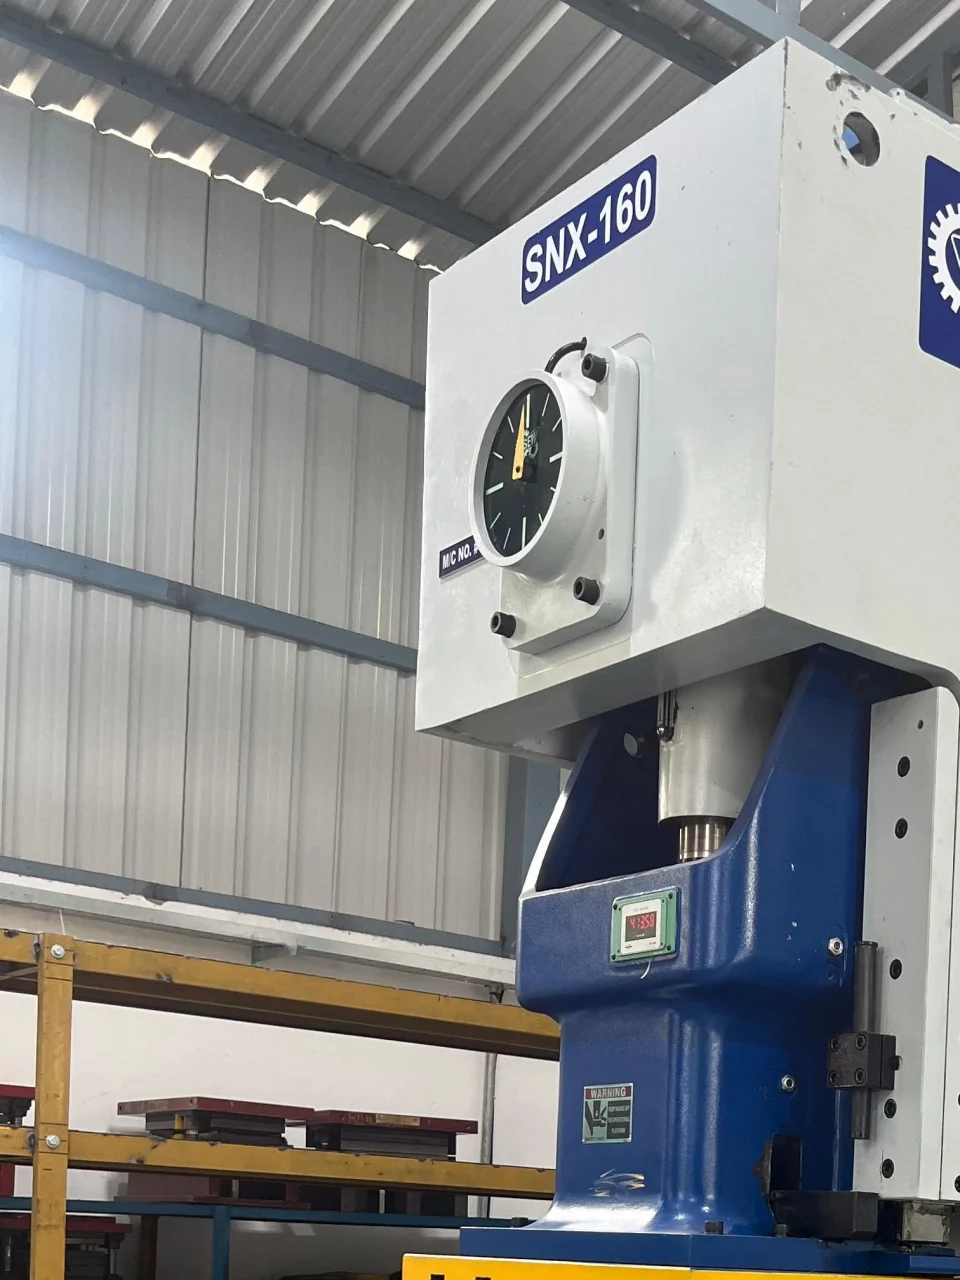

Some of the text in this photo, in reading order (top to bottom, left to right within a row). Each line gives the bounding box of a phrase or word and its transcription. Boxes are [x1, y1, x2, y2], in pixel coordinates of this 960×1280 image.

[524, 170, 652, 293] SNX-160
[457, 543, 472, 563] NO.
[590, 1086, 627, 1099] WARNING
